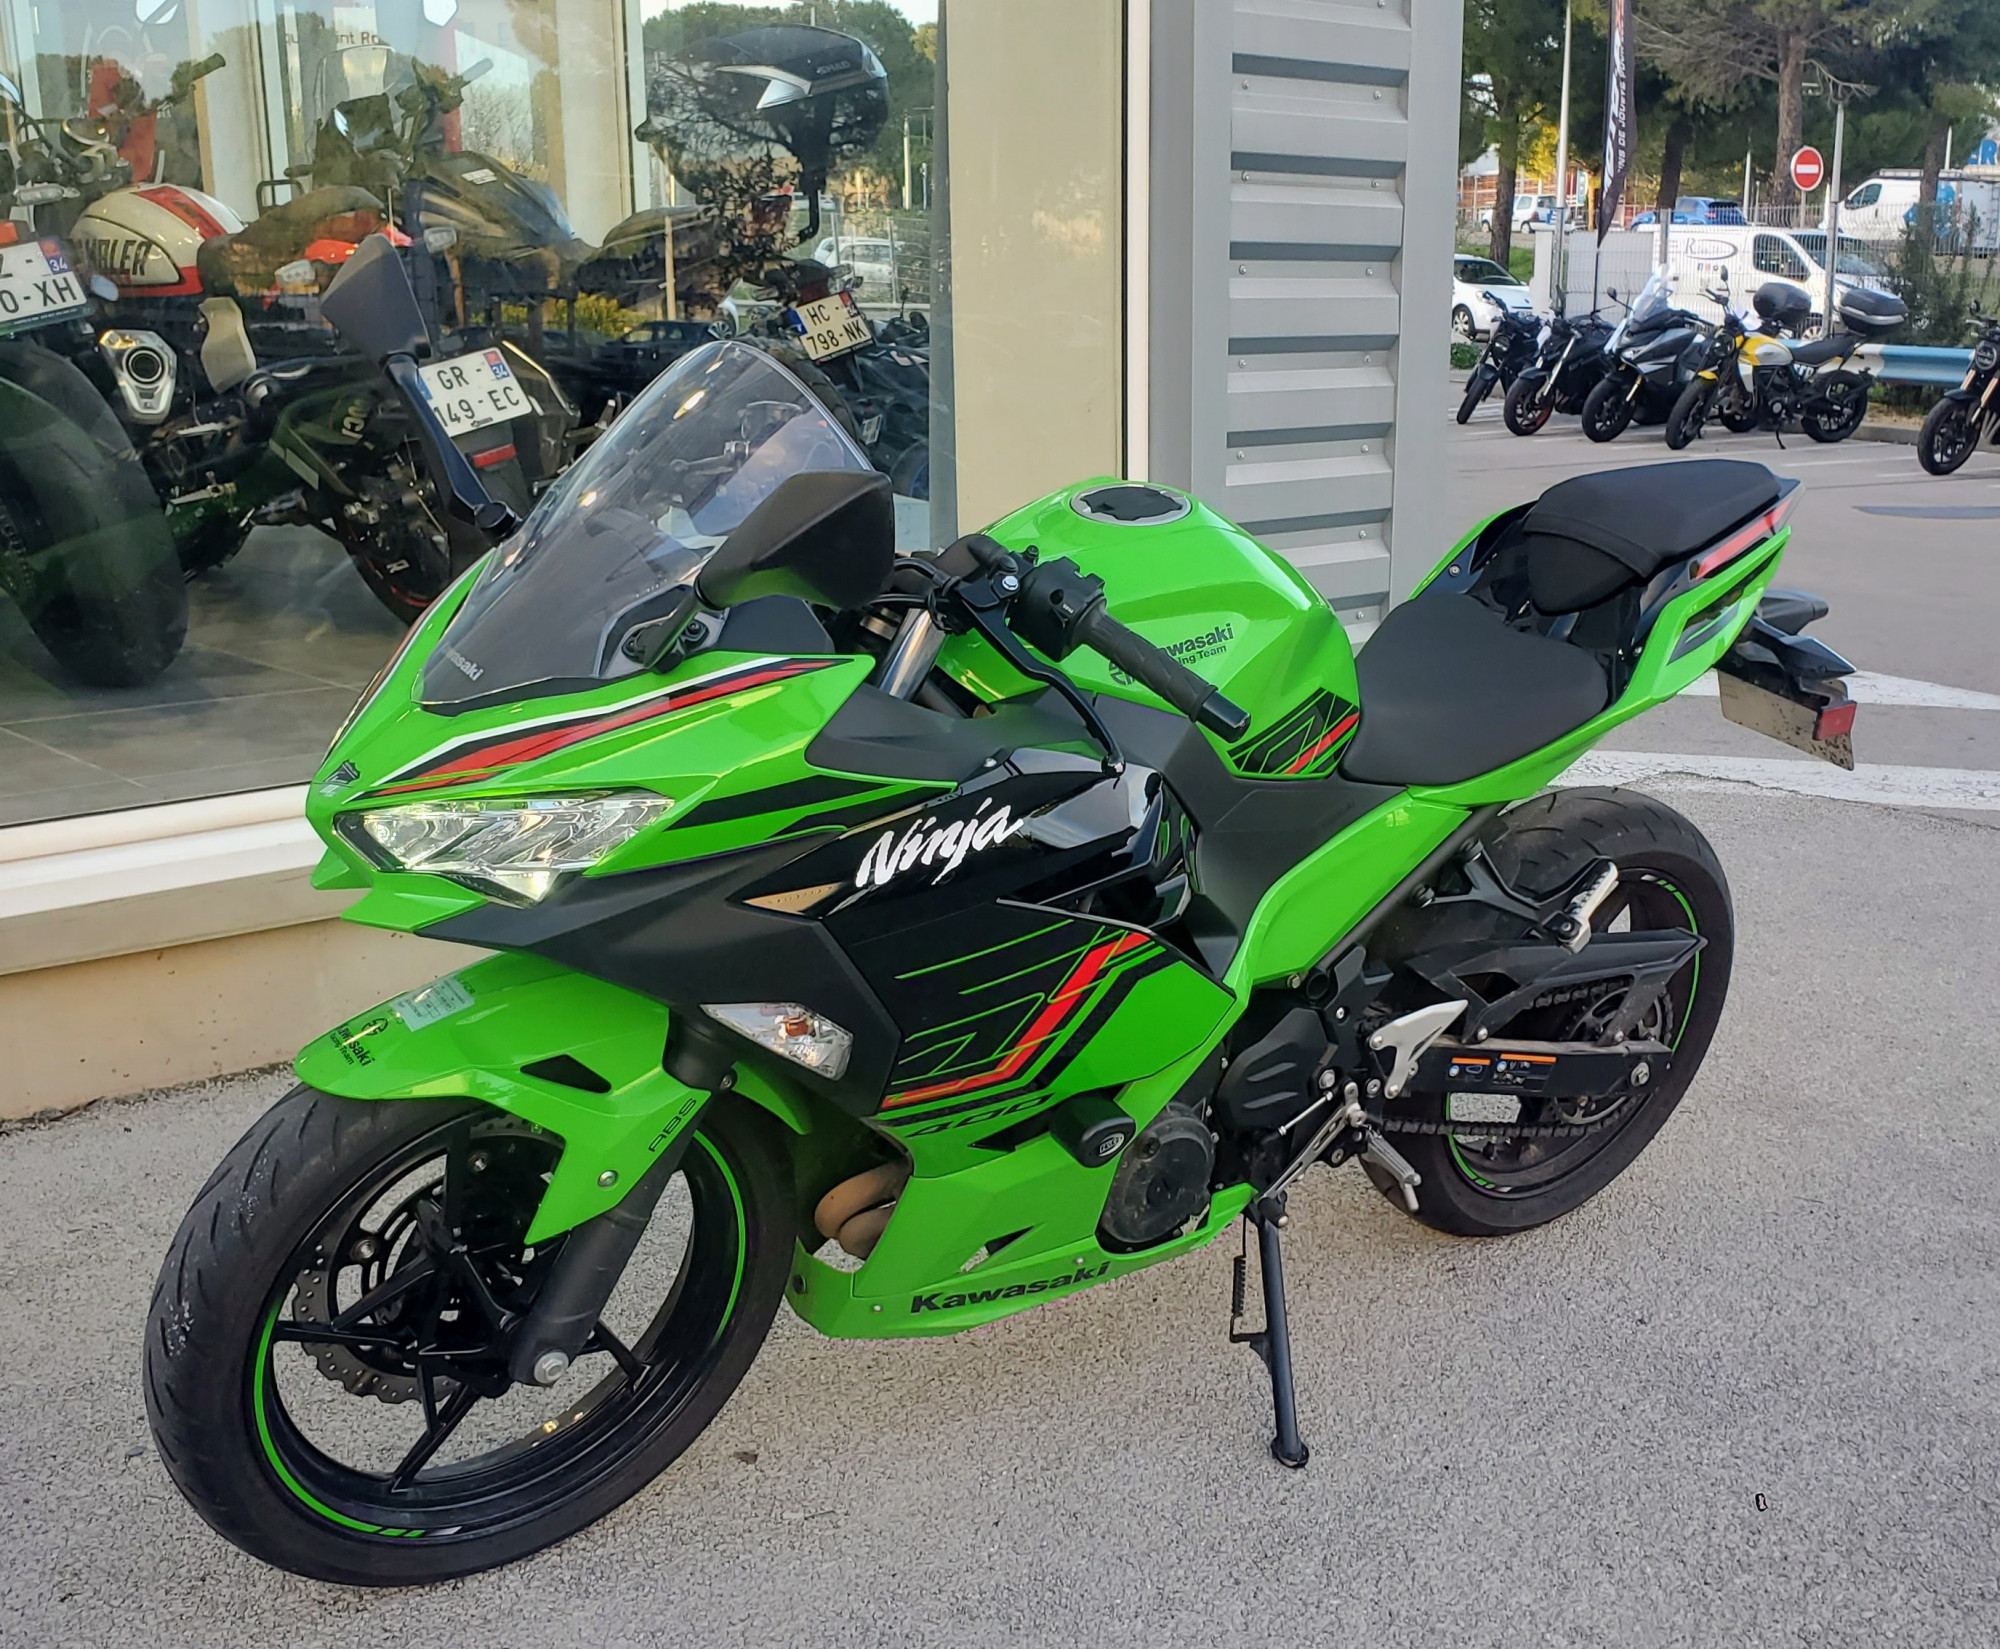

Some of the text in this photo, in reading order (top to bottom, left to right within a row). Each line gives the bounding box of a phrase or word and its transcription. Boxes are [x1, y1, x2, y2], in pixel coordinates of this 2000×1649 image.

[49, 258, 69, 271] 34
[492, 364, 510, 379] 34
[1199, 644, 1228, 660] Team
[855, 797, 1025, 888] Ninja
[339, 1045, 355, 1066] Team
[648, 1097, 697, 1152] ABS
[910, 1260, 1111, 1314] Kawasaki
